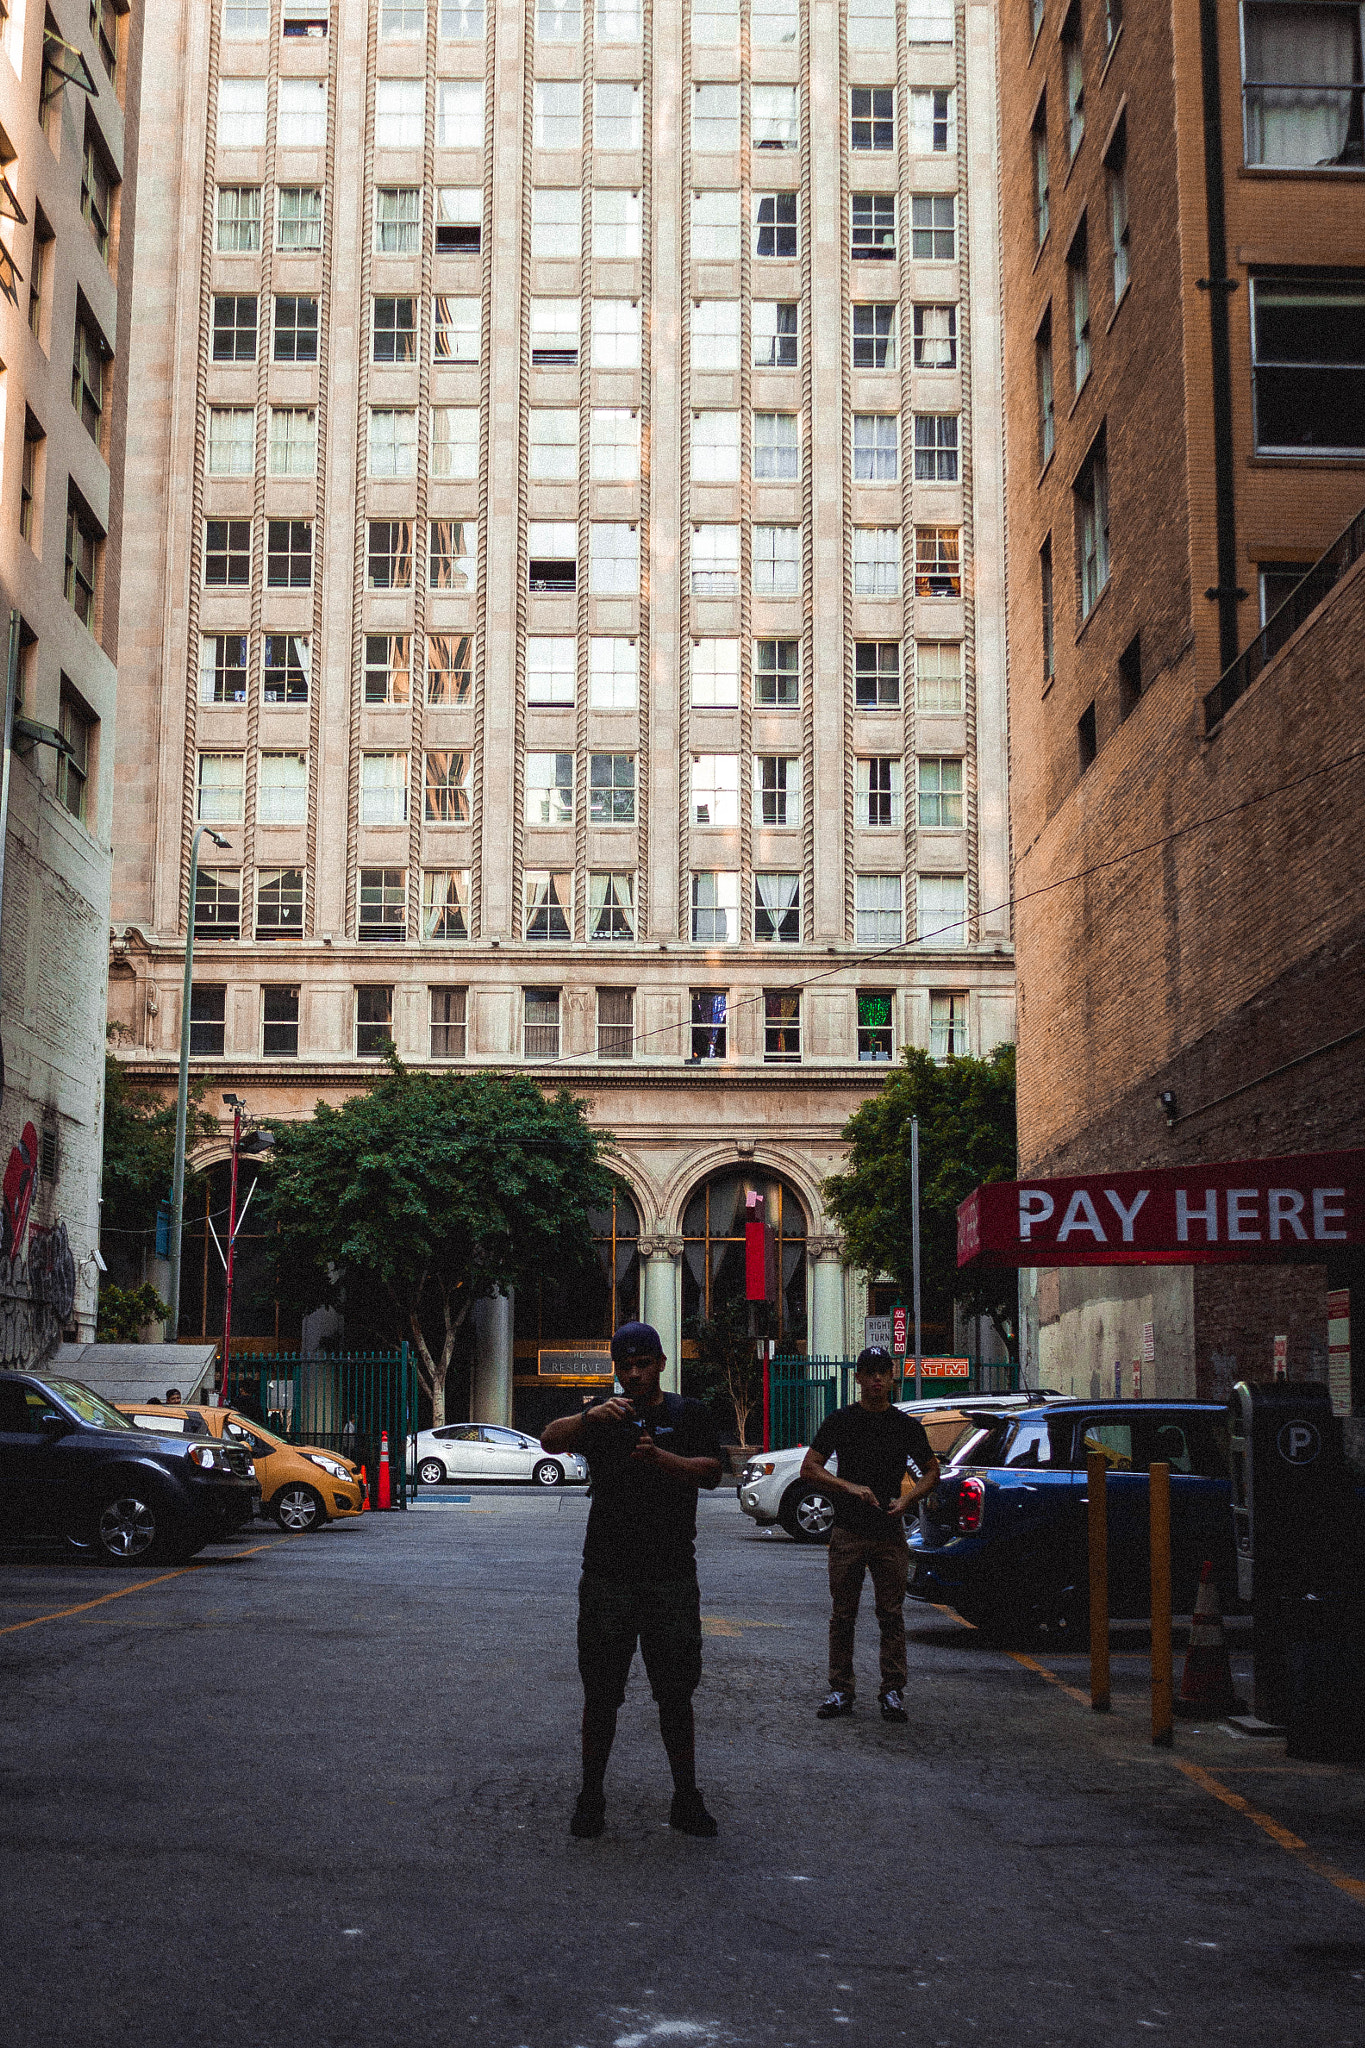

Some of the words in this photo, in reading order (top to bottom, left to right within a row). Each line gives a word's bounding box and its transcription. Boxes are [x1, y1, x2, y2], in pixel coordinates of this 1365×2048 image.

[1018, 1189, 1151, 1242] PAY
[1175, 1188, 1347, 1242] HERE
[868, 1321, 890, 1330] RIGHT
[870, 1333, 890, 1342] TURN
[894, 1320, 905, 1352] ATM
[551, 1362, 600, 1373] RESERVE
[905, 1363, 967, 1376] ATM
[1289, 1426, 1312, 1457] P
